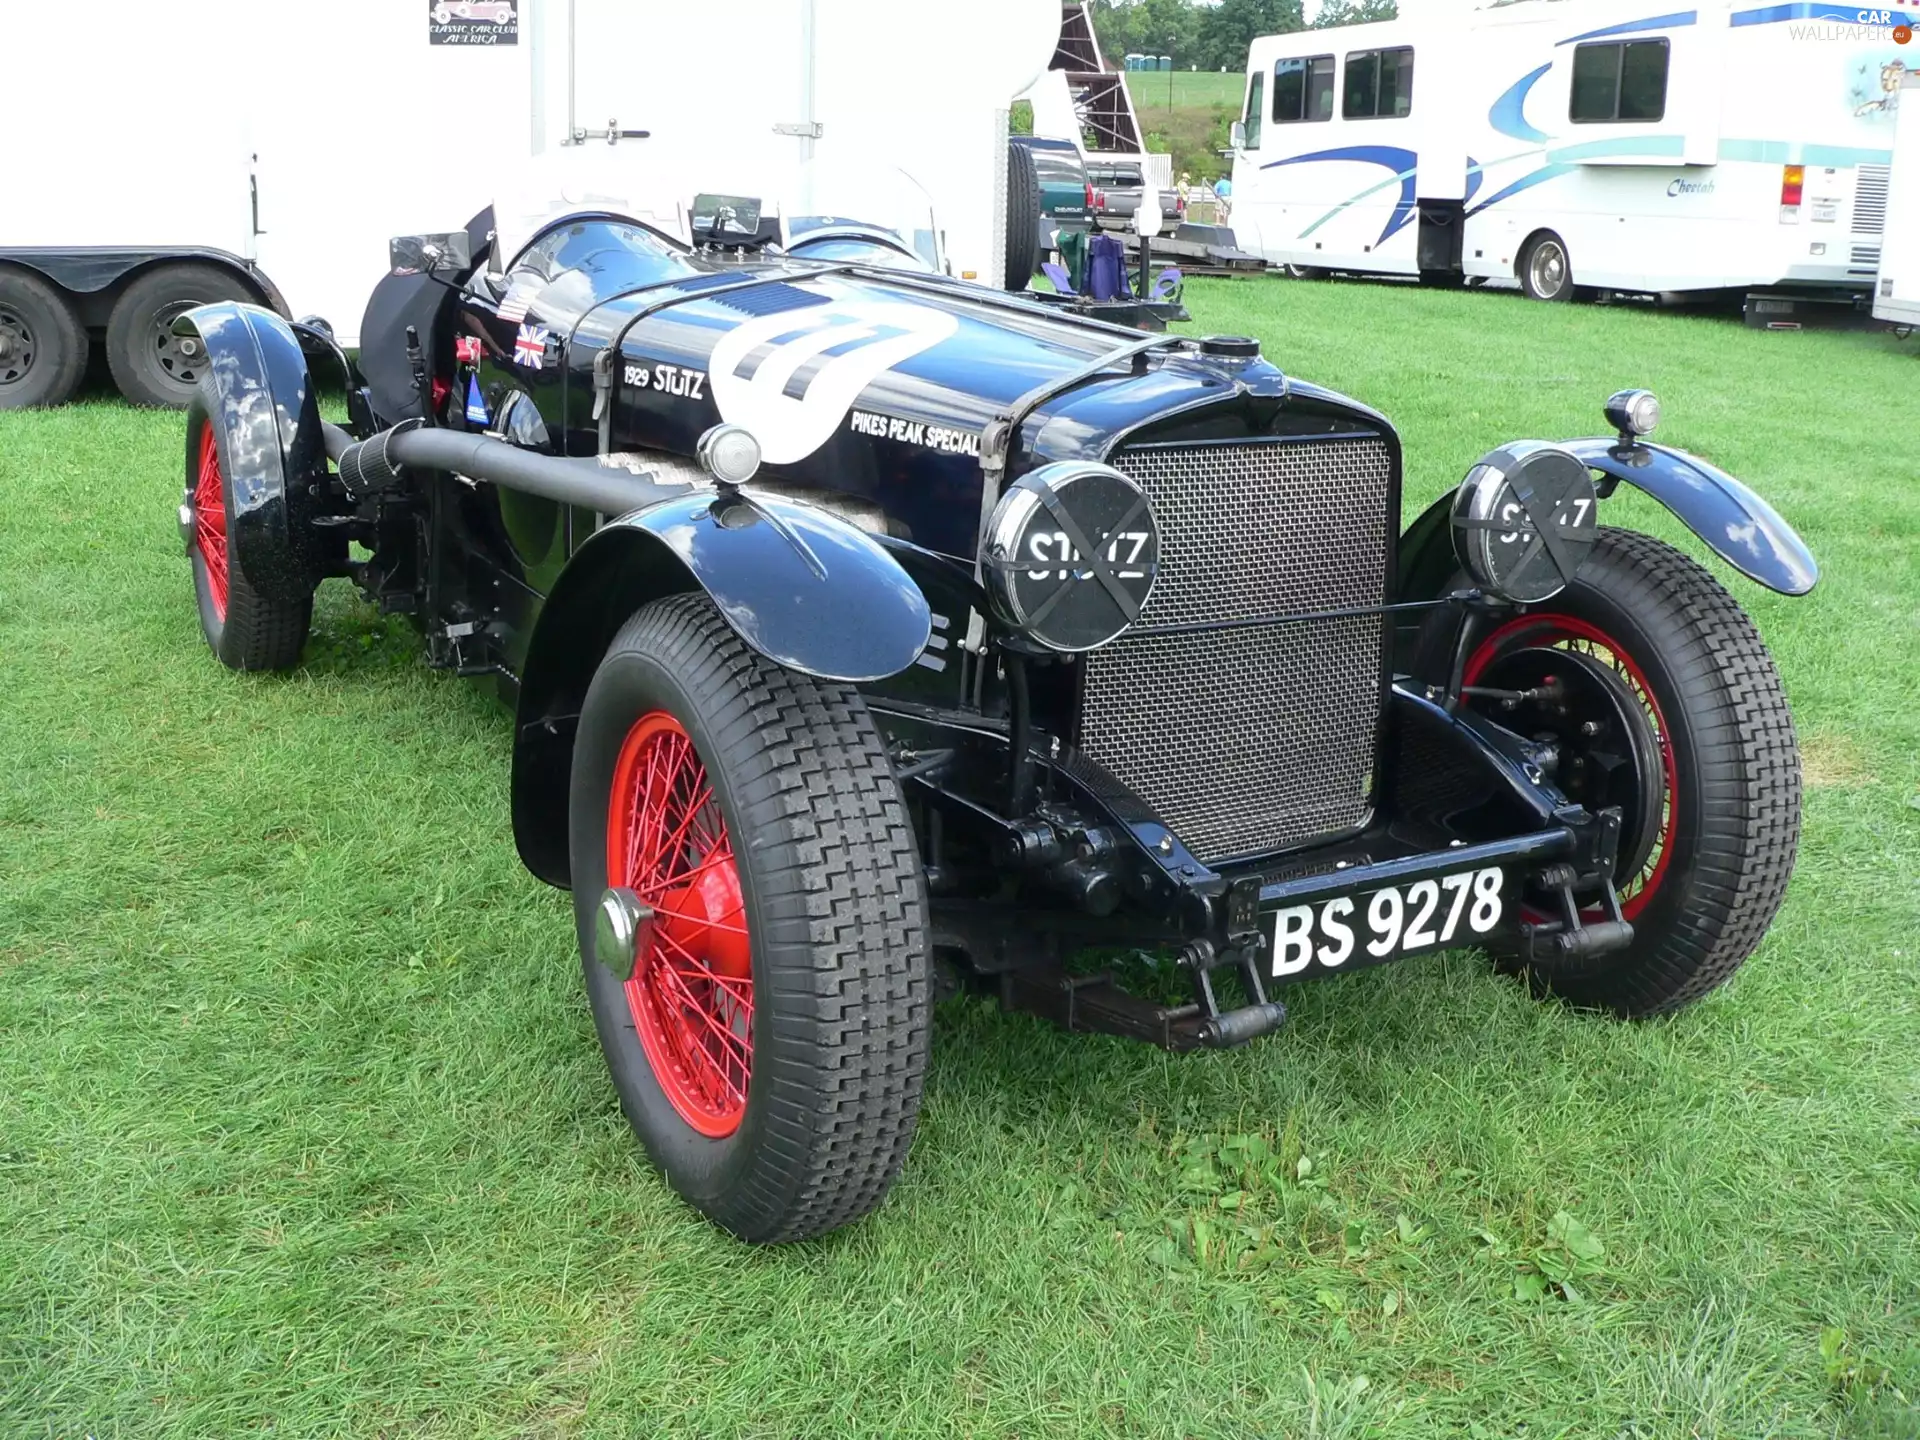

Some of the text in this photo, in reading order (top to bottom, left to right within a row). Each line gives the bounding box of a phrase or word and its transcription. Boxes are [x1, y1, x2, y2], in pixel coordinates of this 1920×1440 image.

[429, 25, 468, 34] CLASSIC
[470, 25, 492, 34] CAR
[442, 34, 497, 44] AMERICA
[1666, 178, 1715, 197] Cheetah
[624, 364, 705, 400] 1929 STUTZ
[851, 411, 980, 457] PIKES PEAK SPECIAL
[1272, 866, 1504, 977] BS 9278
